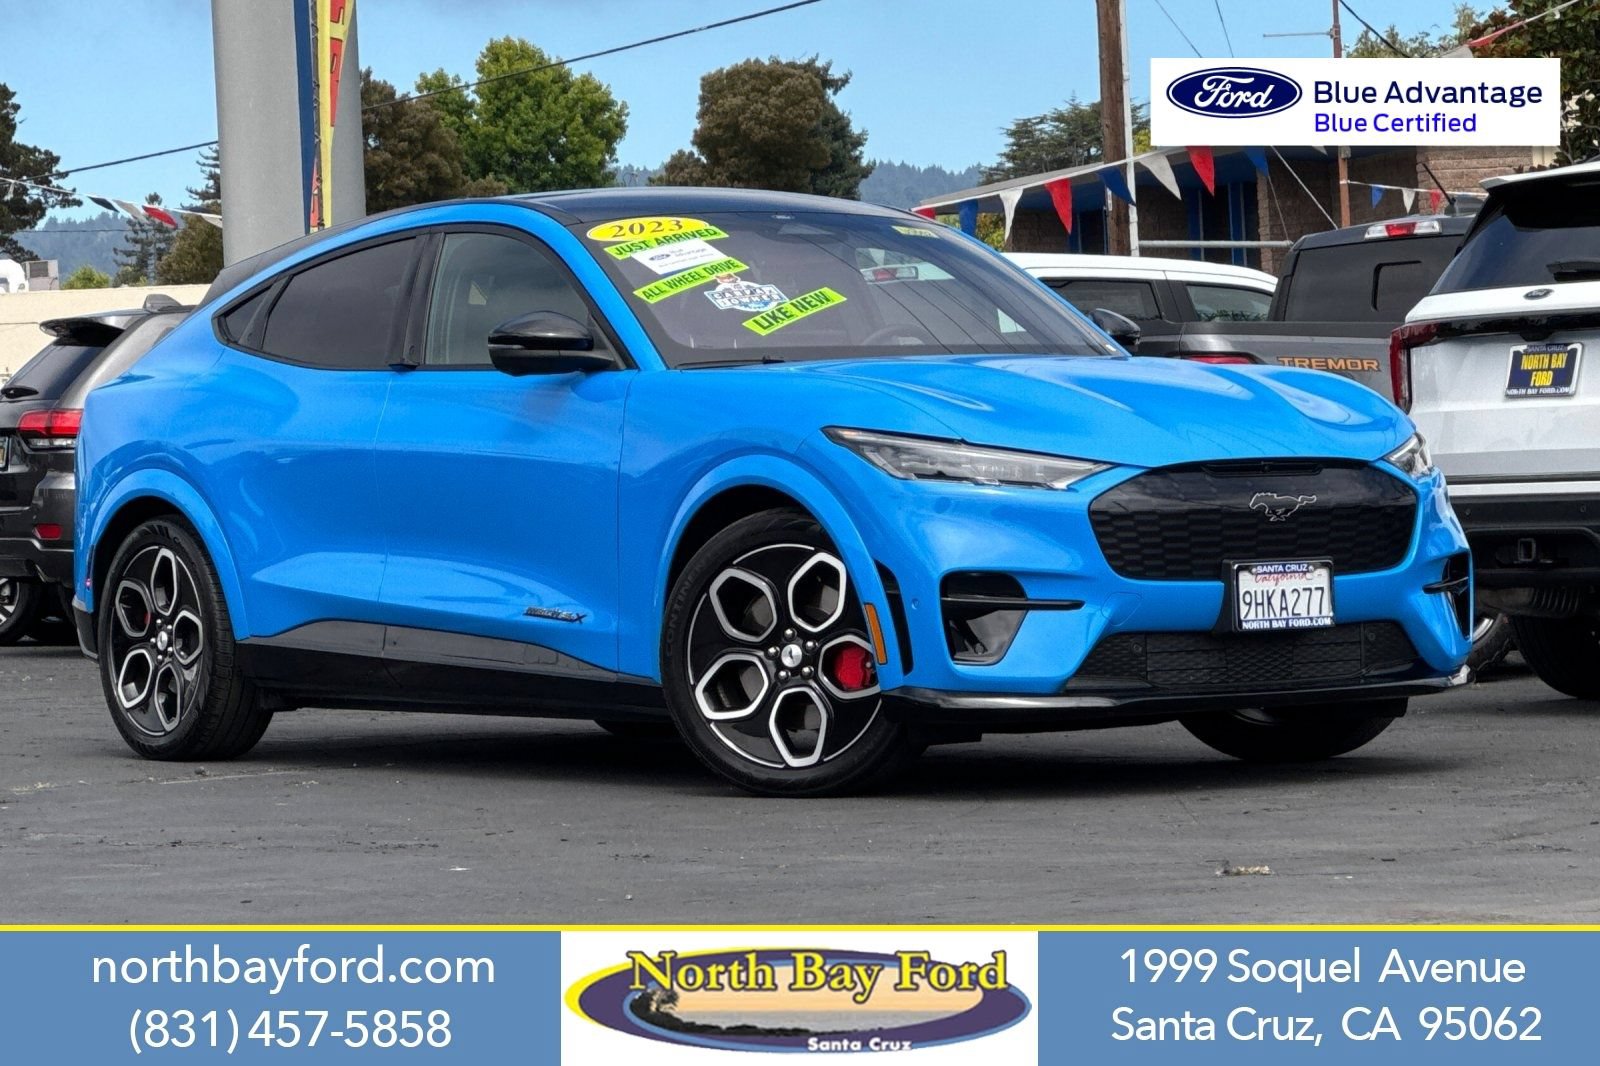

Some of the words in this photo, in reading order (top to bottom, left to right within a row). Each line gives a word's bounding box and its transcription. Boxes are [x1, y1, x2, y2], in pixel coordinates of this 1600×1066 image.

[610, 219, 684, 239] 2023
[614, 239, 651, 256] JUST
[654, 227, 719, 247] ARRIVED
[642, 285, 668, 300] ALL
[662, 270, 706, 290] WHEEL
[703, 259, 739, 276] DRIVE
[752, 306, 795, 330] LIKE
[793, 289, 830, 313] NEW
[1277, 357, 1379, 371] TREMOR
[1521, 354, 1549, 370] NORTH
[1551, 353, 1568, 368] BAY
[1530, 371, 1553, 386] FORD
[1256, 564, 1285, 573] SANTA
[1285, 564, 1308, 572] CRUZ
[1242, 587, 1325, 619] 9HKA277
[1242, 620, 1270, 630] NORTH
[1272, 619, 1287, 628] BAY
[1289, 617, 1331, 627] FORD.COM
